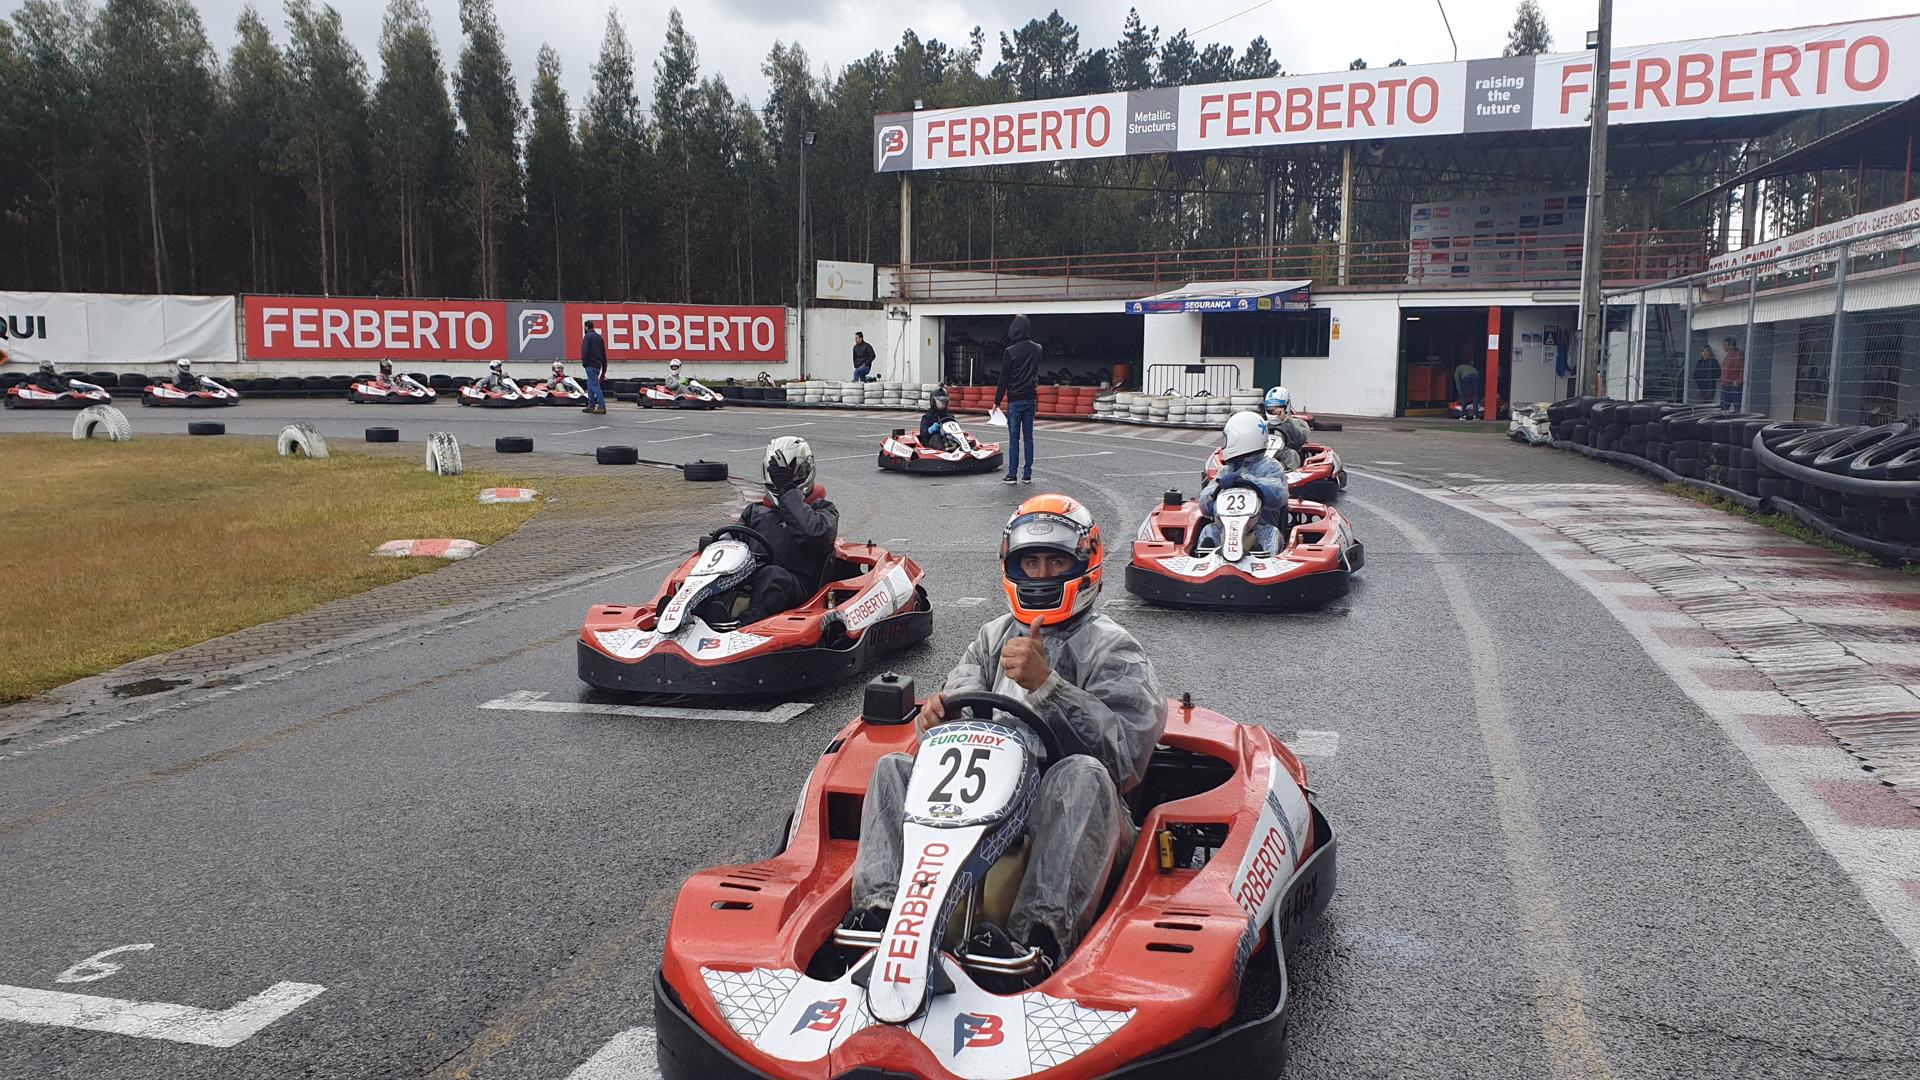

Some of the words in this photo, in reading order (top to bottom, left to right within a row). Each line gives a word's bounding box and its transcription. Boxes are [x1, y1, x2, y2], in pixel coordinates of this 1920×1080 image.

[1476, 75, 1525, 91] raising
[1560, 35, 1890, 114] FERBERTO
[1200, 76, 1438, 138] FERBERTO
[1476, 101, 1521, 116] future
[1487, 89, 1511, 103] the
[927, 105, 1111, 160] FERBERTO
[1128, 120, 1177, 134] Structures
[1134, 110, 1171, 124] Metallic
[1185, 301, 1231, 311] SEGURANÇA
[263, 307, 493, 349] FERBERTO
[581, 313, 775, 352] FERBERTO
[1226, 495, 1246, 511] 23
[1228, 520, 1240, 553] FERBERTO
[707, 549, 725, 569] 9
[664, 580, 704, 622] FERBERTO
[846, 589, 889, 630] FERBERTO
[929, 733, 1006, 747] EUROINDY
[927, 747, 991, 804] 25
[882, 842, 950, 985] FERBERTO
